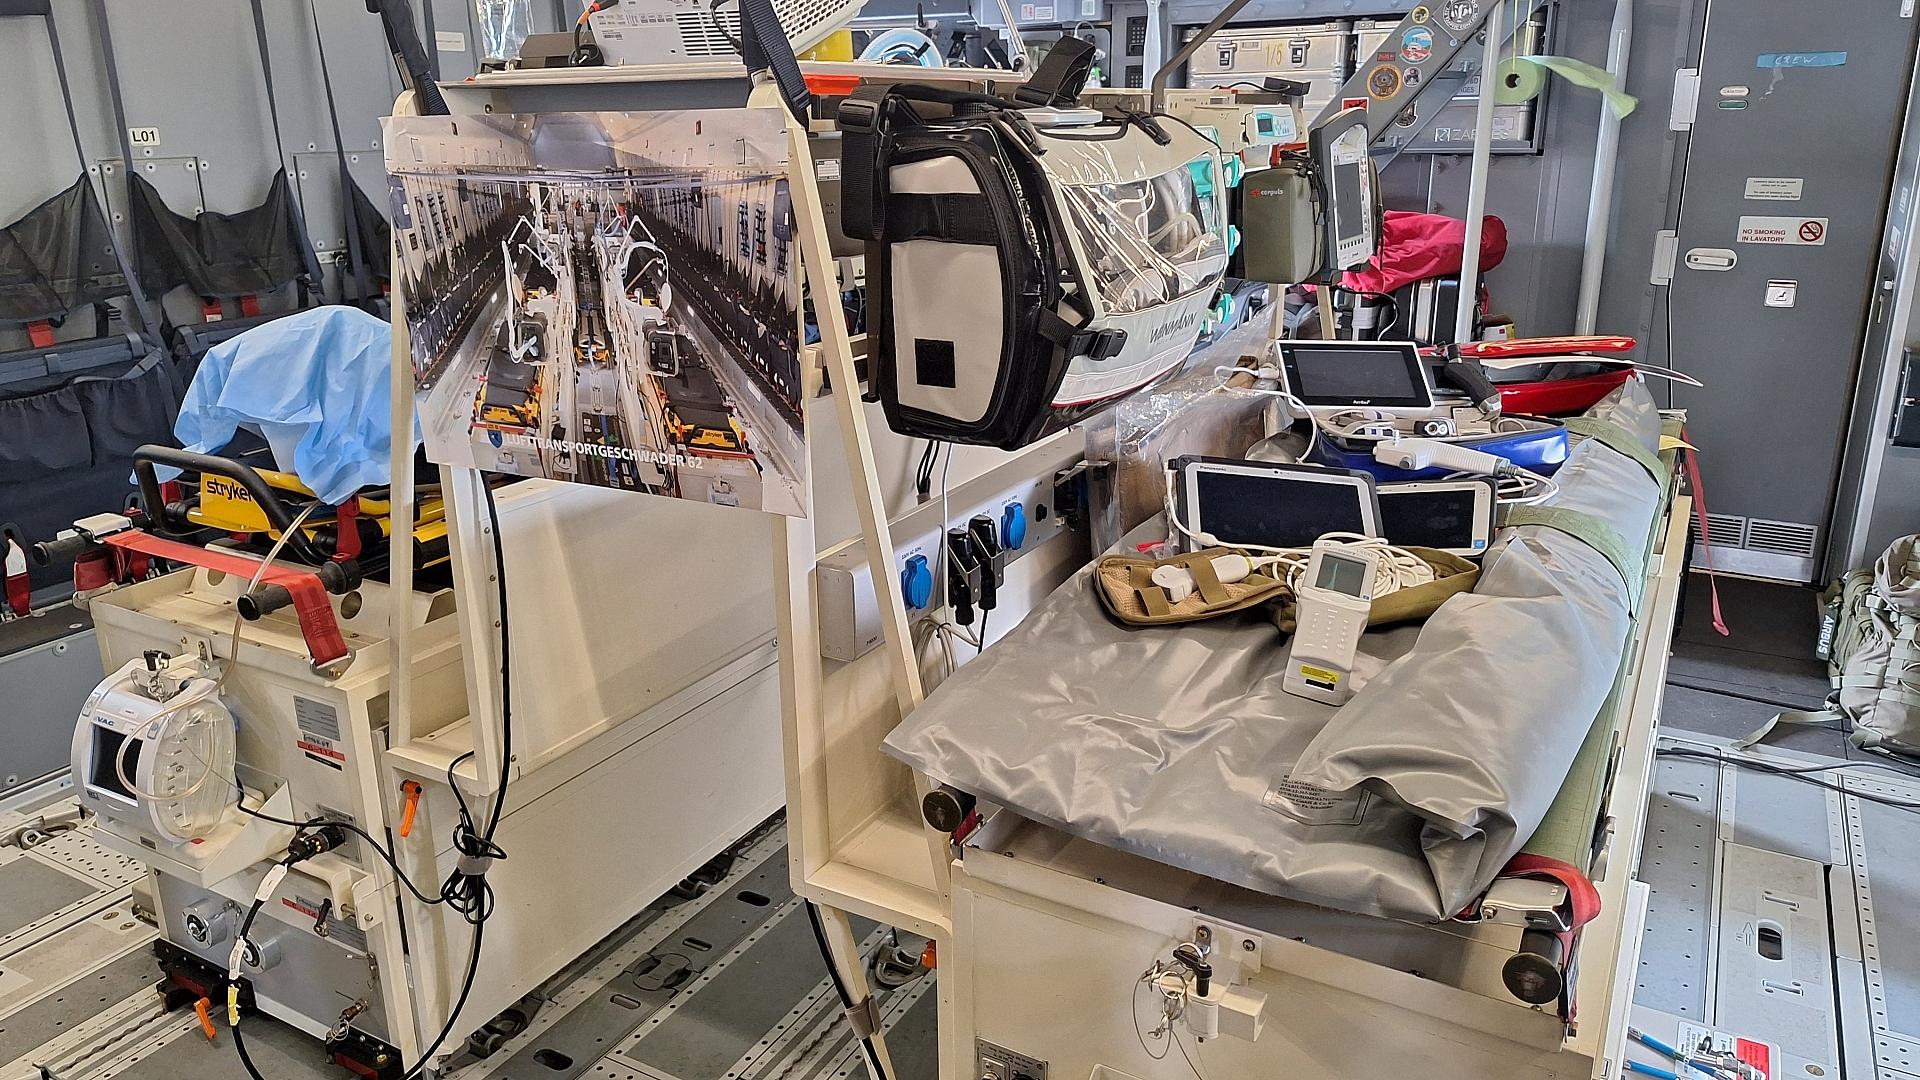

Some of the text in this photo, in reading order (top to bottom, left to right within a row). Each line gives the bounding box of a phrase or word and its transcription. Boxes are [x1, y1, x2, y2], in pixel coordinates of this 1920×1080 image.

[1774, 55, 1818, 65] CREW
[132, 130, 156, 142] L01
[1260, 188, 1284, 197] corpuls
[506, 433, 704, 470] LUFTTRANSPORTGESCHWADER 62
[1818, 614, 1835, 654] AIRBUS
